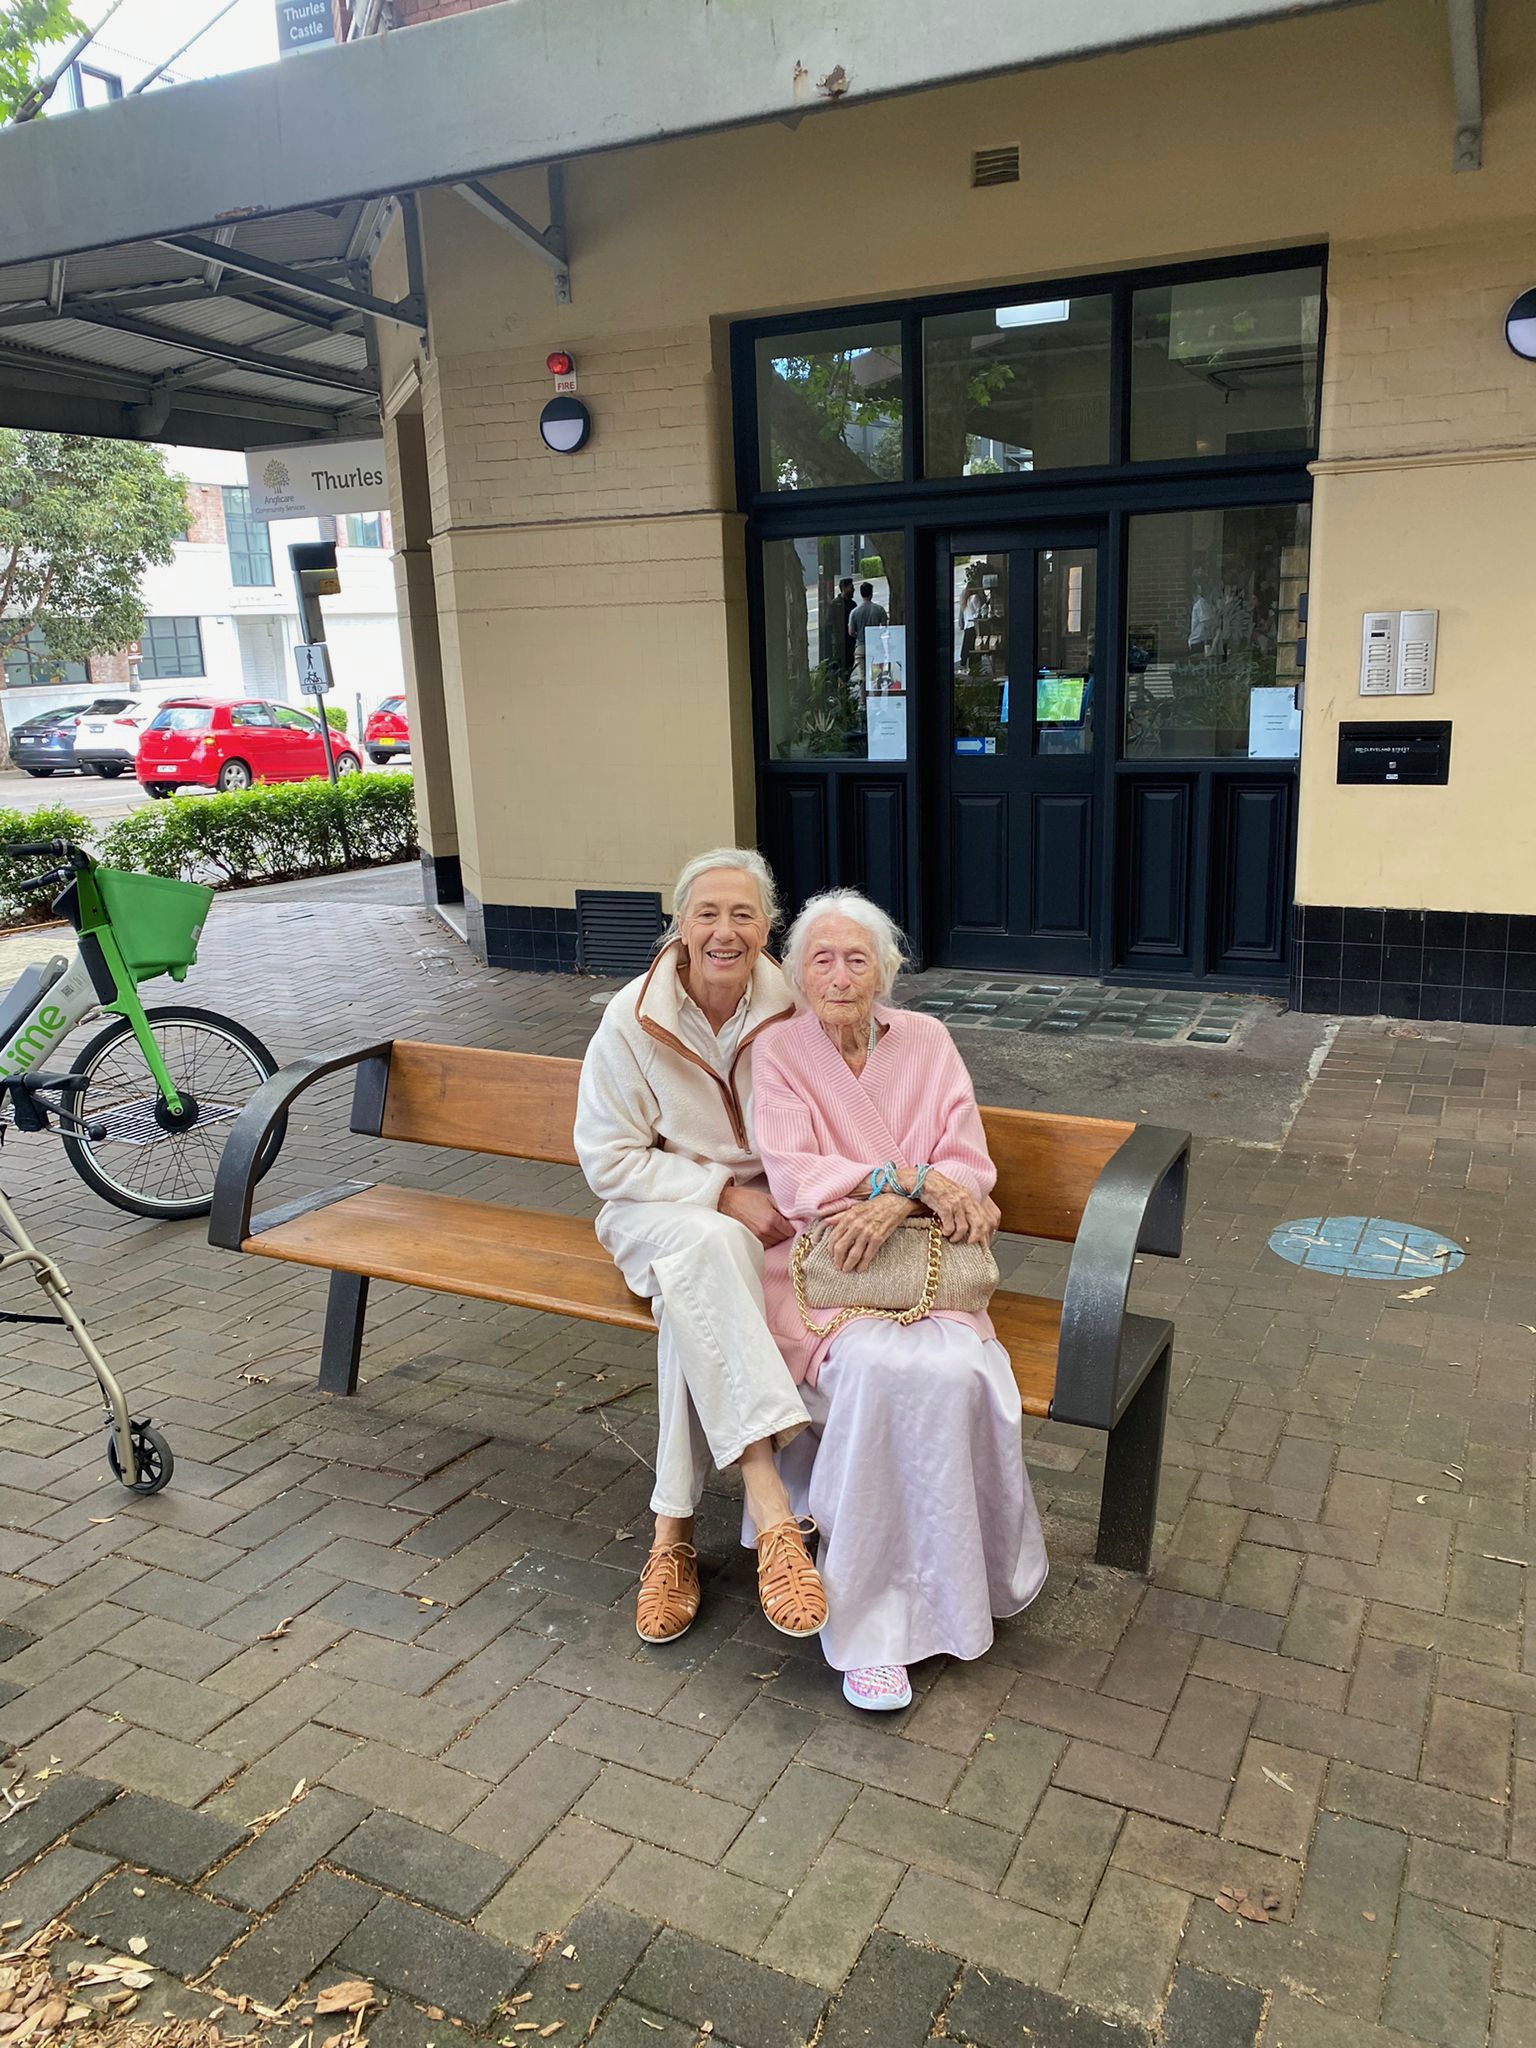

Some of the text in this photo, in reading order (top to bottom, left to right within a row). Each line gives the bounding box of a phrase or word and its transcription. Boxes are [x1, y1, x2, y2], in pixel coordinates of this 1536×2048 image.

[284, 2, 326, 22] Thurles
[289, 22, 323, 40] Castle
[557, 381, 575, 391] FIRE
[311, 467, 383, 491] Thurles
[264, 495, 295, 505] Anglicare
